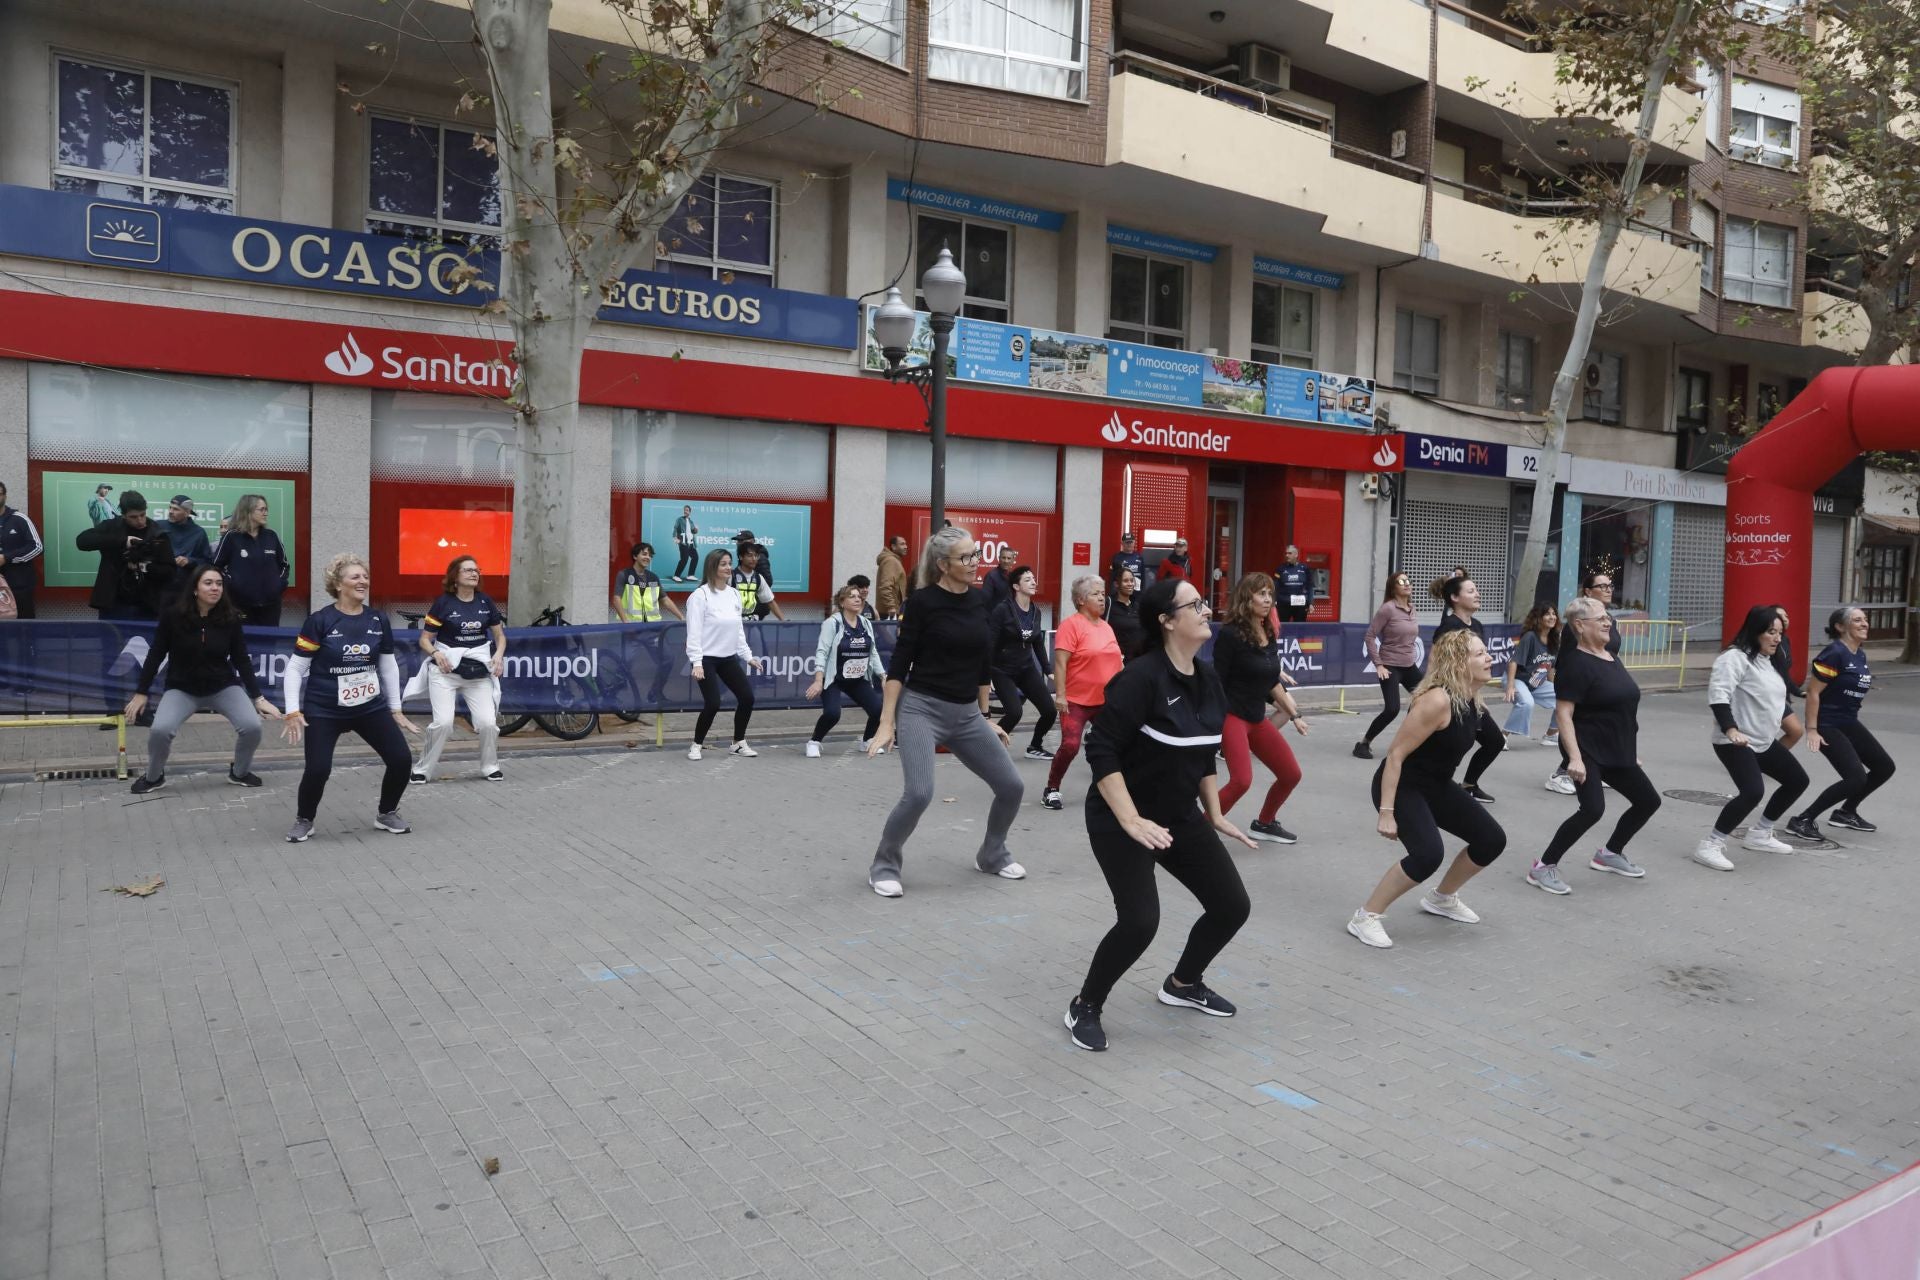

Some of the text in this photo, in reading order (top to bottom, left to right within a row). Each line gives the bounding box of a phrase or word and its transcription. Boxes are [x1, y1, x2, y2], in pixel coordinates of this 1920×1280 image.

[901, 186, 1039, 224] IMMOBILIER MAKELAAR
[232, 227, 471, 295] OCASO
[382, 346, 520, 388] Santan
[1136, 354, 1200, 376] inmoconcept
[1131, 421, 1230, 452] Santander
[1468, 444, 1489, 466] FM
[131, 480, 216, 491] BIENESTANDO
[1624, 470, 1652, 492] Petit
[701, 505, 758, 514] BIENESTANDO
[959, 516, 1004, 525] BIENESTANDO
[1735, 513, 1771, 526] Sports
[696, 535, 730, 545] meses
[1732, 532, 1791, 543] Santander
[503, 648, 597, 685] mupol
[343, 683, 375, 700] 2376
